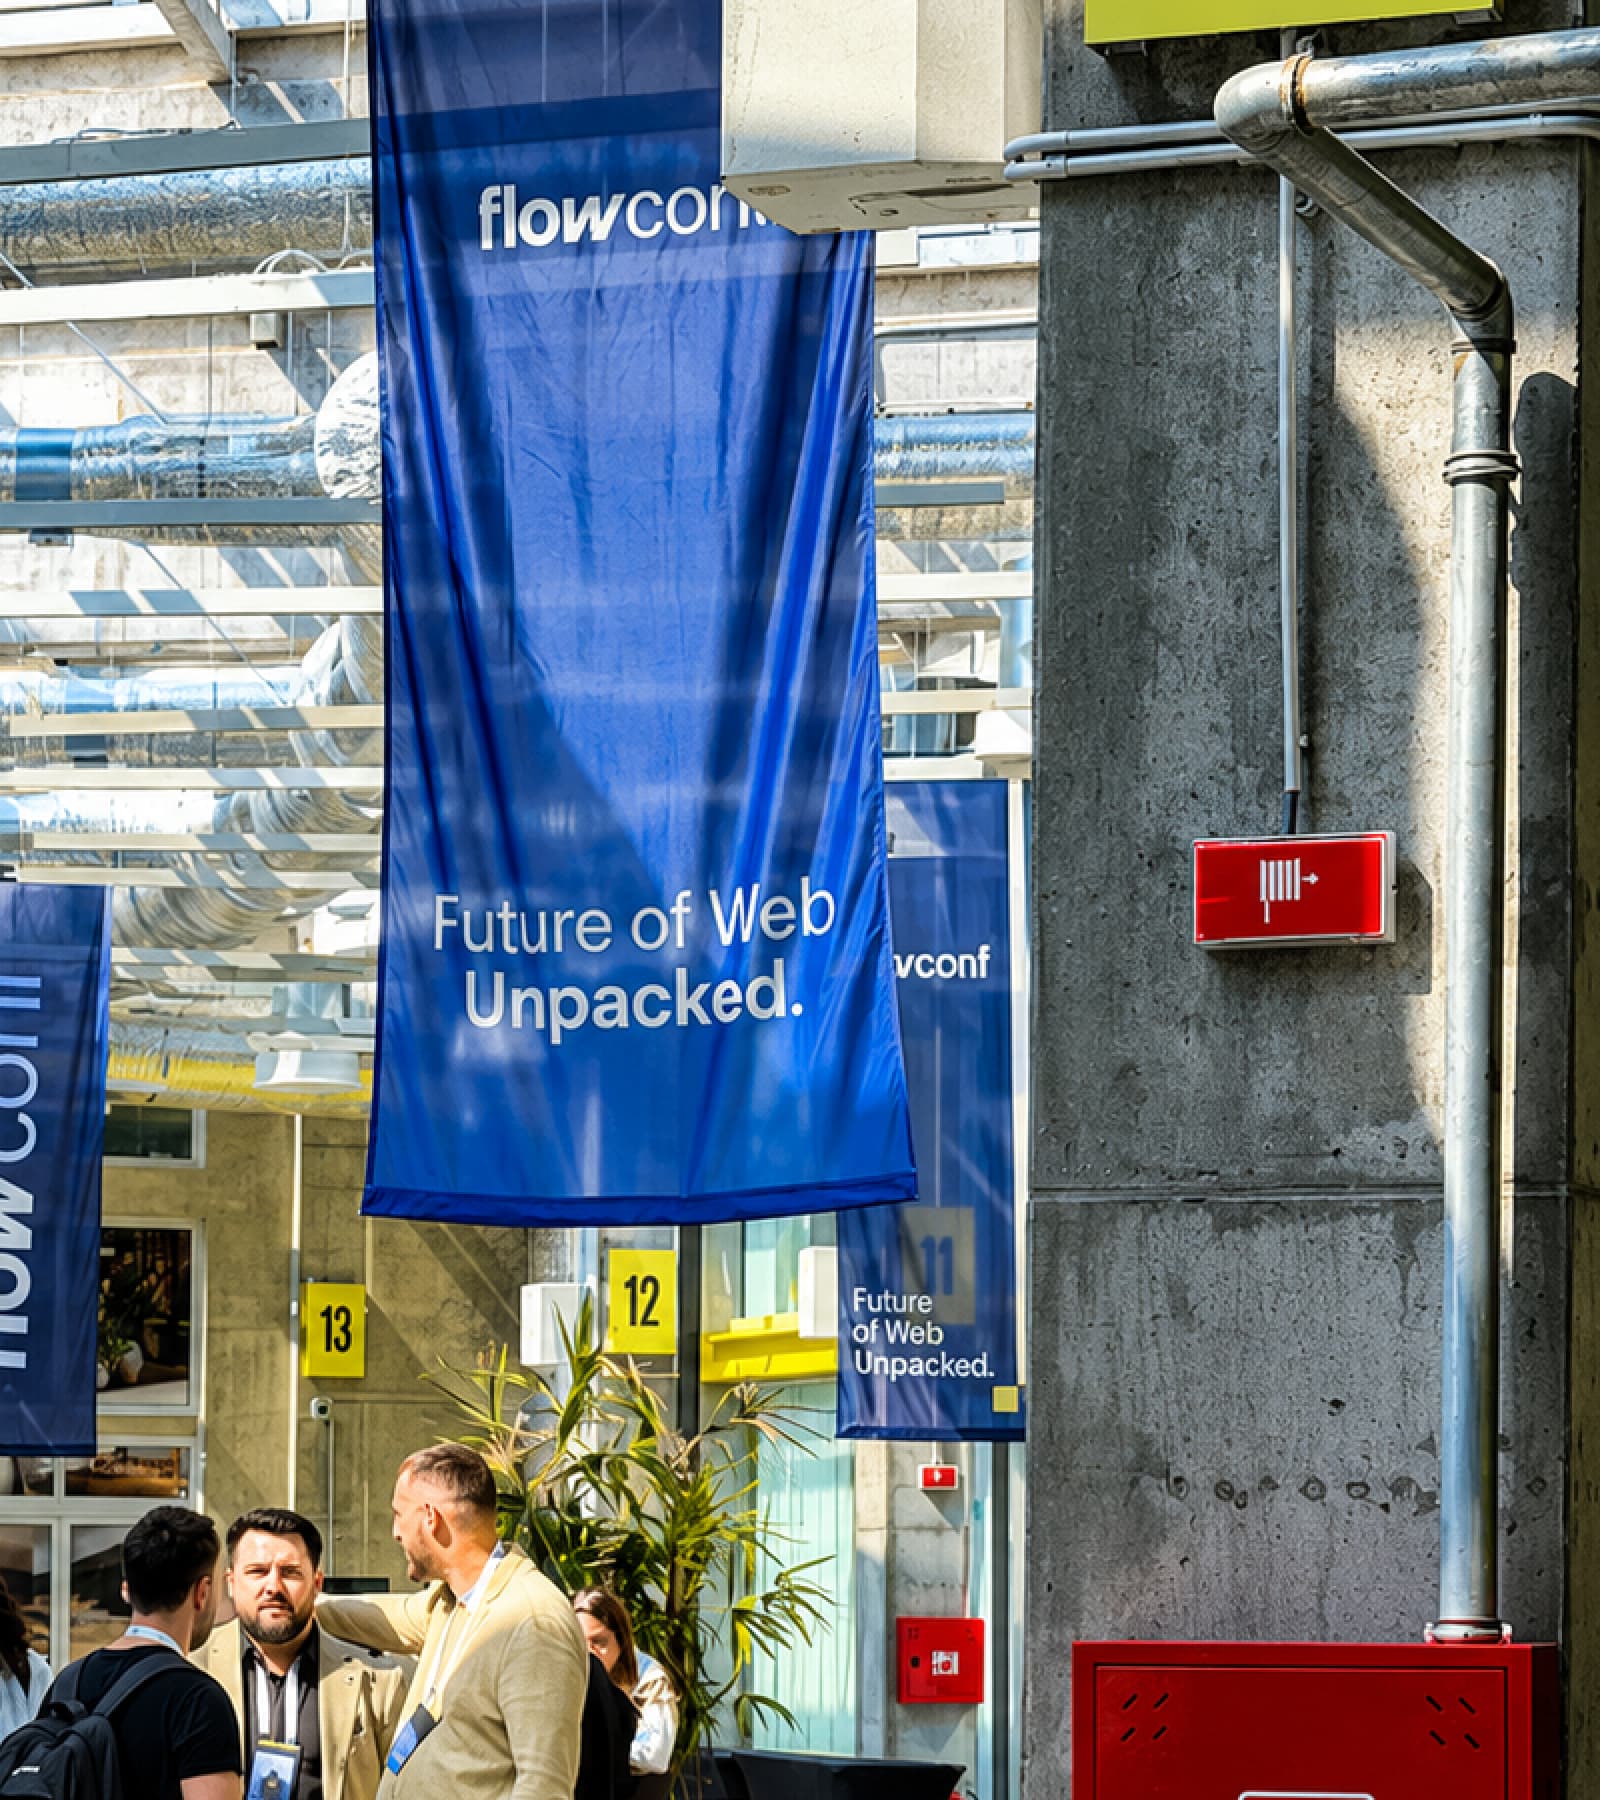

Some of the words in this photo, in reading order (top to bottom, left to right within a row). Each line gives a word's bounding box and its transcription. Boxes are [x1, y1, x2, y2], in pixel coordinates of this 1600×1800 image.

[479, 183, 767, 250] flowcon
[434, 894, 613, 954] Future
[631, 890, 692, 950] of
[709, 875, 836, 947] Web
[466, 957, 803, 1045] Unpacked.
[624, 1275, 661, 1328] 12
[853, 1287, 933, 1315] Future
[320, 1304, 353, 1353] 13
[852, 1318, 879, 1344] of
[885, 1319, 945, 1346] Web
[855, 1350, 995, 1383] Unpacked.
